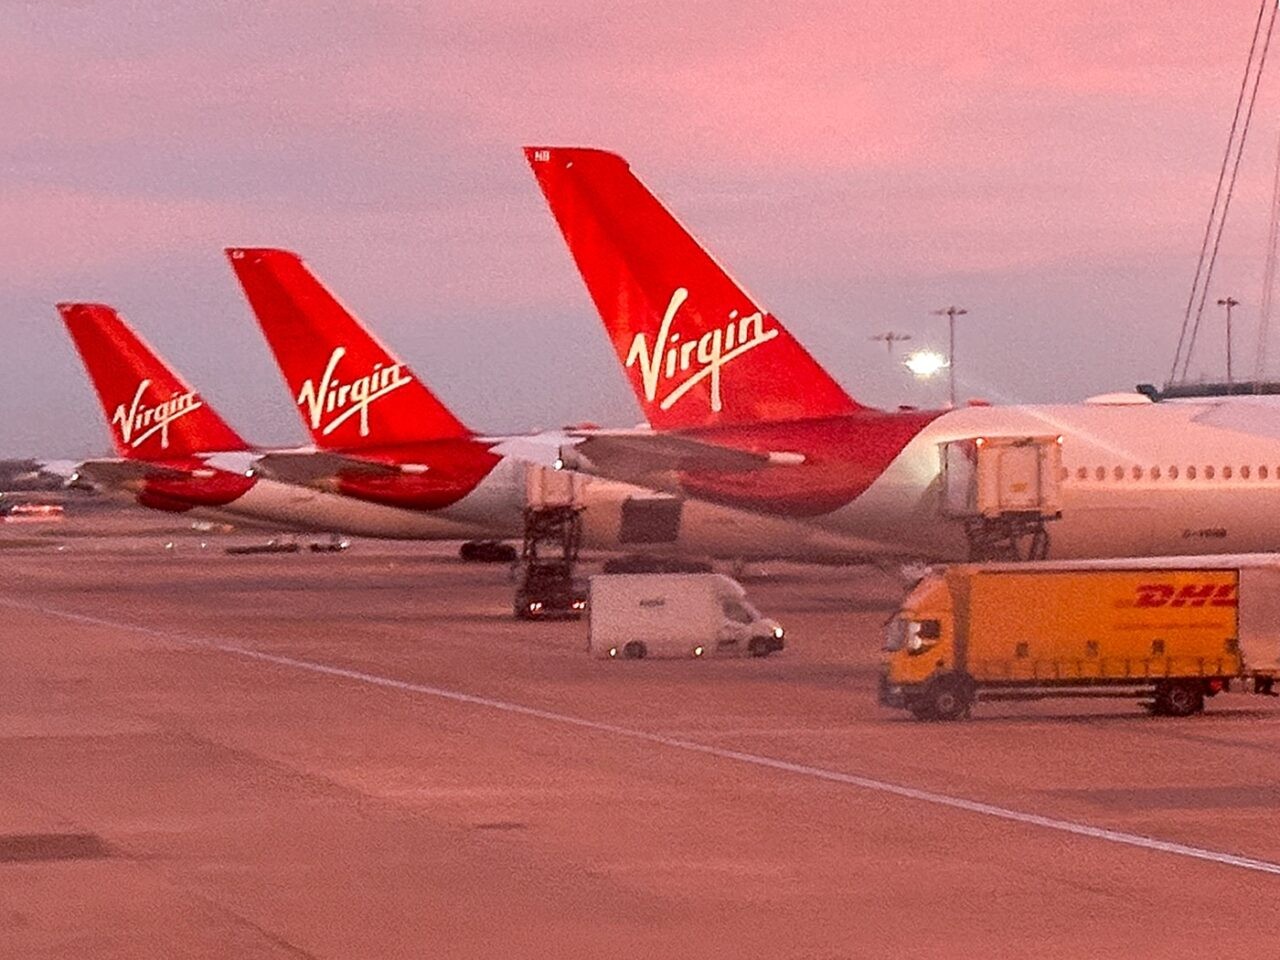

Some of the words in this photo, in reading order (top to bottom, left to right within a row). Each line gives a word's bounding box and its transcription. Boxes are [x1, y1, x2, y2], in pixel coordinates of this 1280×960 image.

[626, 288, 778, 411] Virgin
[112, 379, 202, 449] Virgin
[298, 347, 412, 436] Virgin
[1134, 584, 1237, 608] DHL
